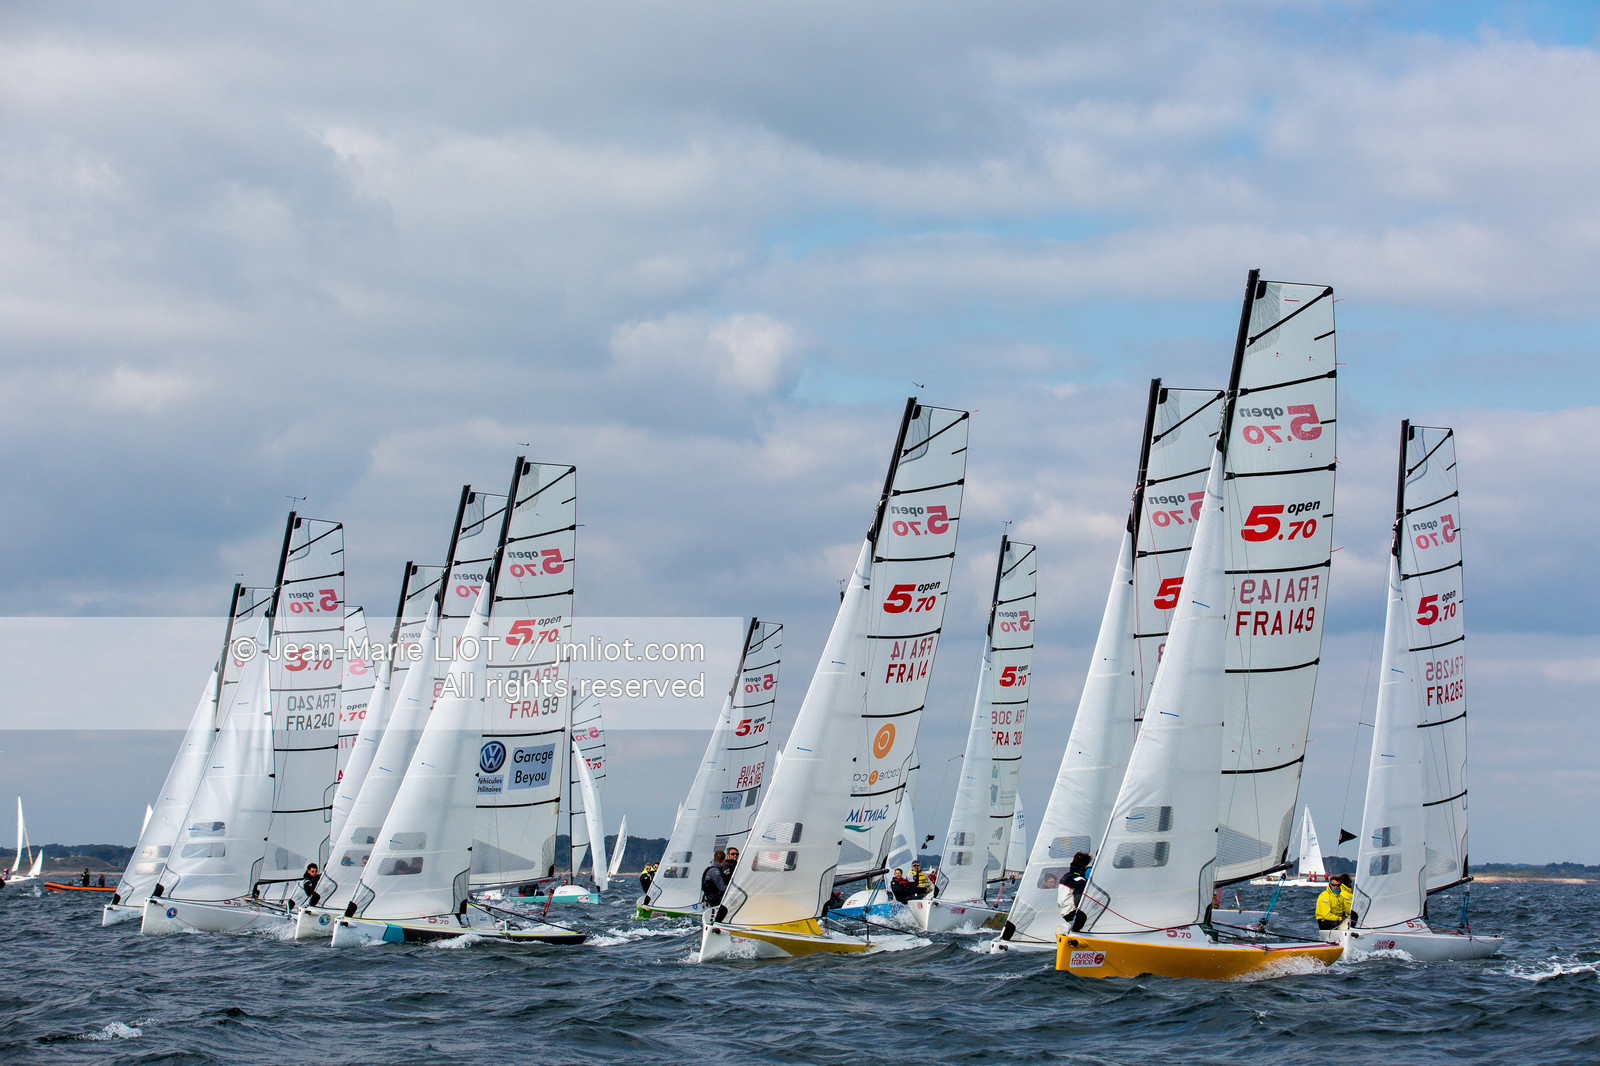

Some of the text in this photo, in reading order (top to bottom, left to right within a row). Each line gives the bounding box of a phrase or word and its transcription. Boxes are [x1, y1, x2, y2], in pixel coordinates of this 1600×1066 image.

[1288, 500, 1320, 516] open
[1240, 504, 1317, 542] 5.70
[918, 582, 940, 594] open
[1442, 590, 1456, 602] open
[883, 584, 936, 614] 5.70
[1416, 594, 1456, 626] 5.70
[538, 616, 562, 627] open
[506, 619, 558, 646] 5.70
[999, 666, 1026, 687] 5.70
[286, 712, 334, 731] FRA240
[735, 719, 764, 736] 5.70
[514, 750, 553, 764] Garage
[515, 770, 546, 786] Beyou
